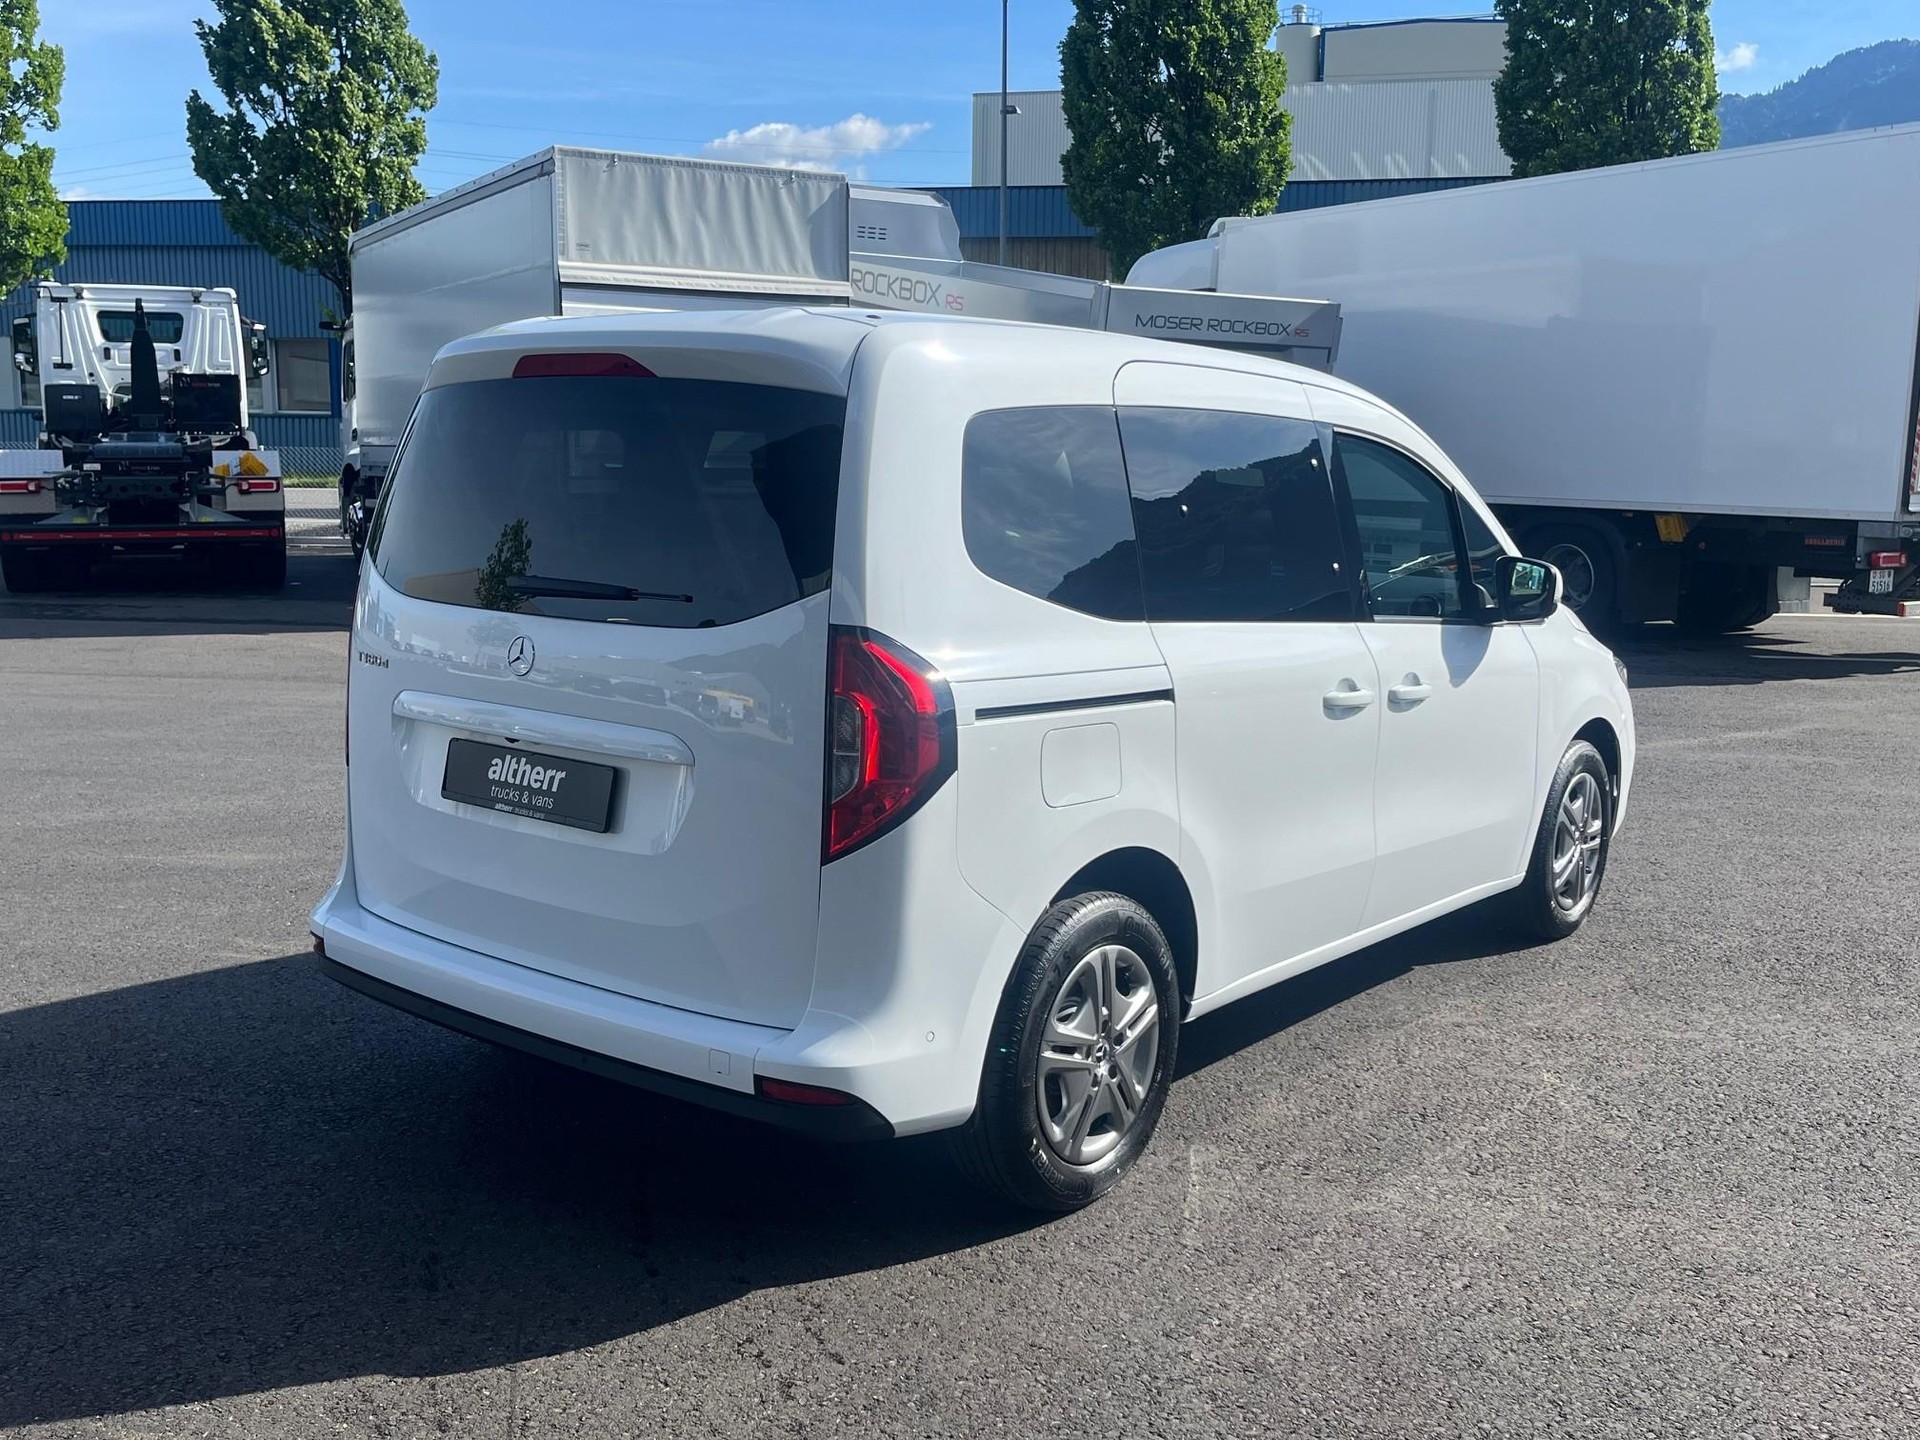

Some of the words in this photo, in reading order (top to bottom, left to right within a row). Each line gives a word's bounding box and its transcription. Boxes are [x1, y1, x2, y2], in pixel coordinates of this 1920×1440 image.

[850, 268, 942, 307] ROCKBOX
[945, 293, 965, 311] RS
[1135, 313, 1203, 331] MOSER
[1206, 318, 1291, 337] ROCKBOX
[1294, 328, 1310, 338] RS
[488, 754, 566, 792] altherr
[490, 784, 520, 802] trucks
[521, 791, 530, 804] &
[532, 794, 554, 809] vans
[494, 803, 513, 812] altherr
